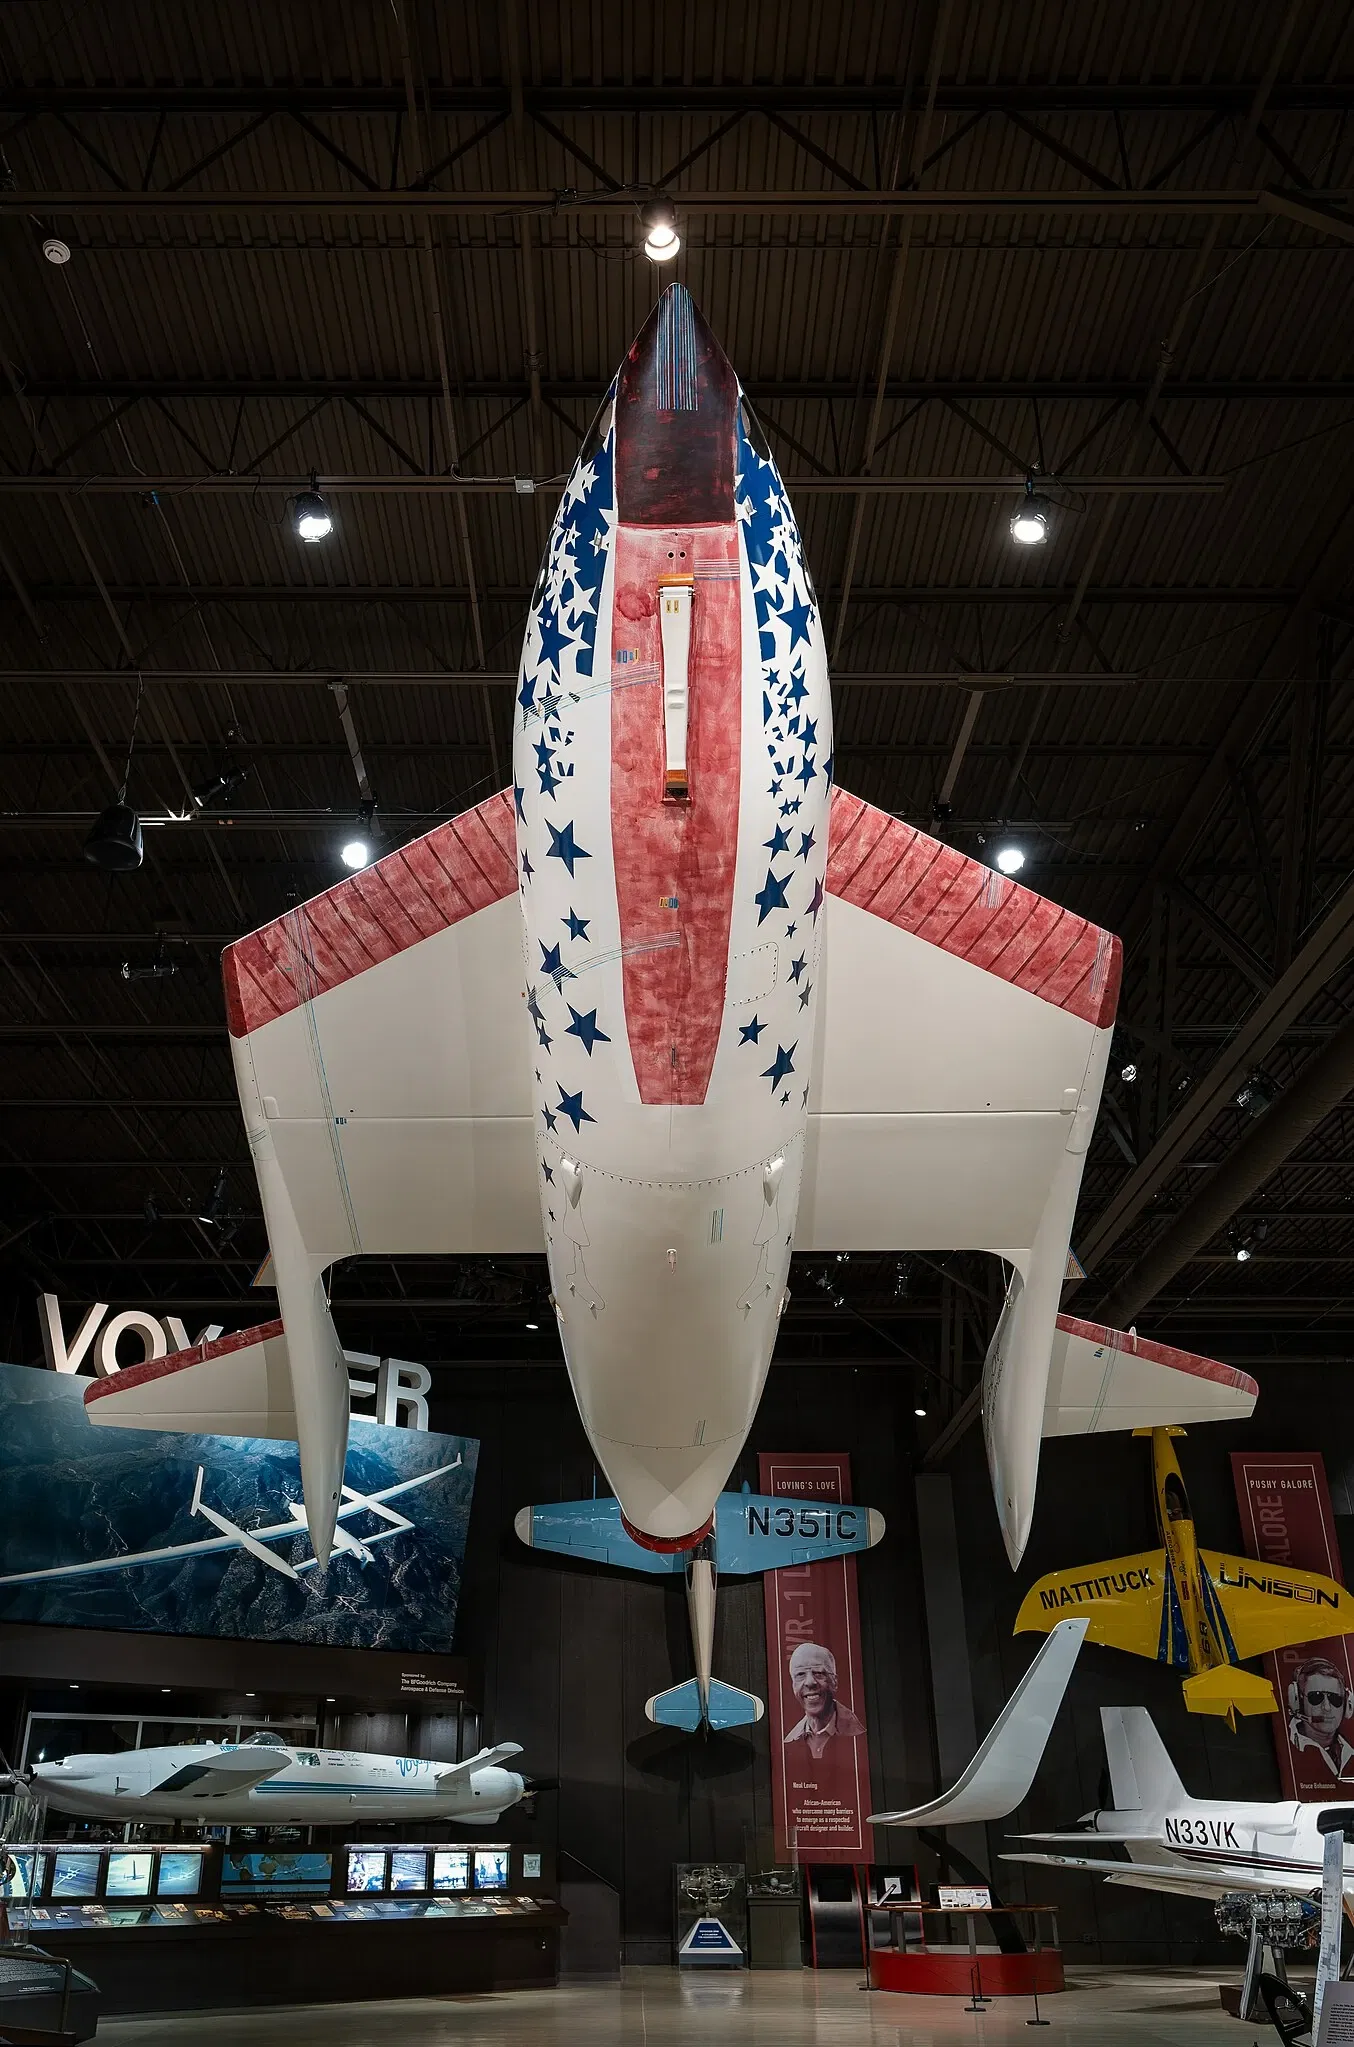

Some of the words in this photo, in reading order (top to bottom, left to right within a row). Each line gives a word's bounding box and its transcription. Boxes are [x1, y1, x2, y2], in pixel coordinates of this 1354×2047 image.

[36, 1293, 432, 1432] VOYER
[777, 1481, 813, 1490] LOVING'S
[816, 1481, 836, 1490] LOVE
[1250, 1480, 1277, 1489] PUSHY
[1281, 1480, 1313, 1489] GALORE
[1257, 1495, 1293, 1566] ALORE
[1040, 1567, 1155, 1610] MATTITUCK
[1220, 1562, 1339, 1609] UNISON
[803, 1782, 818, 1790] Loving
[810, 1824, 828, 1832] designer
[1165, 1818, 1240, 1848] N33VK
